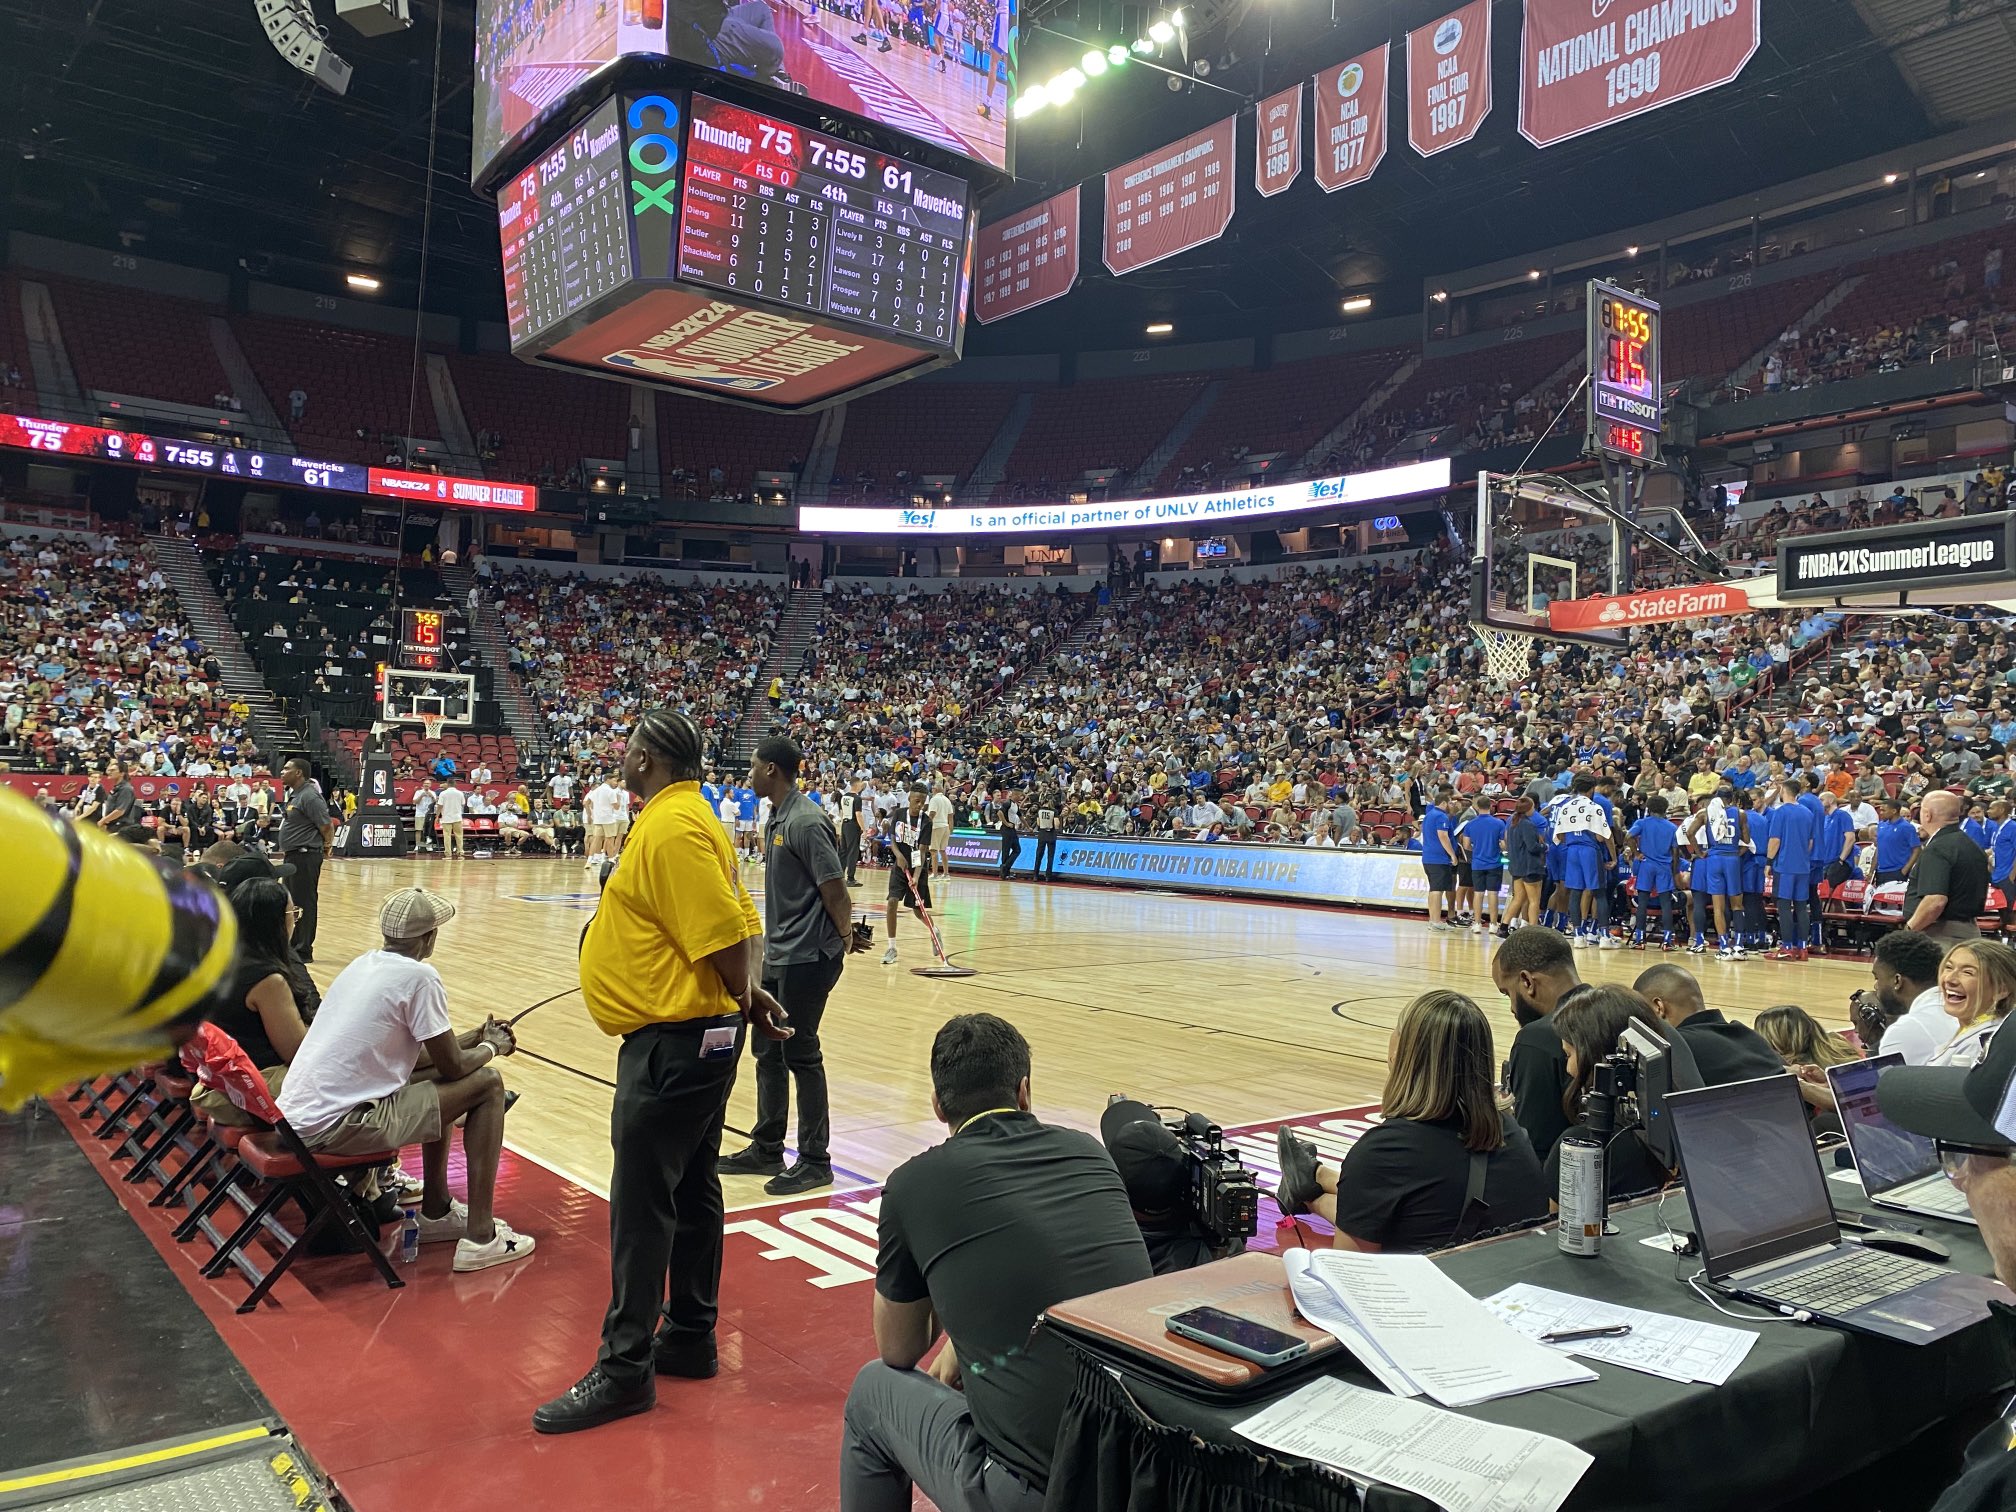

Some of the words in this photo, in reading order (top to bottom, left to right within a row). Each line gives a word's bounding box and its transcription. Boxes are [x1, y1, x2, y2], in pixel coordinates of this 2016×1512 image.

[1537, 21, 1619, 88] NATIONAL
[1624, 0, 1738, 56] CHAMPIONS
[1437, 55, 1458, 81] NCAA
[1605, 51, 1661, 108] 1990
[1427, 83, 1448, 107] FINAL
[1449, 71, 1469, 98] FOUR
[1340, 98, 1359, 122] NCAA
[1429, 94, 1466, 136] 1987
[1331, 124, 1349, 146] FINAL
[1350, 115, 1368, 138] FOUR
[521, 172, 535, 201] 75
[540, 147, 566, 187] 7:55
[573, 128, 588, 160] 61
[628, 95, 678, 216] COX
[693, 118, 752, 154] Thunder
[758, 123, 792, 155] 75
[809, 140, 866, 179] 7:55
[884, 165, 912, 194] 61
[913, 187, 963, 220] Mavericks
[1266, 151, 1290, 179] 1989
[1333, 136, 1365, 174] 1977
[693, 165, 721, 182] PLAYER
[733, 177, 748, 190] PTS
[759, 184, 774, 197] RBS
[785, 192, 799, 205] AST
[810, 199, 823, 211] FLS
[756, 164, 773, 179] FLS
[780, 171, 789, 186] 0
[821, 184, 848, 203] 4th
[877, 200, 893, 215] FLS
[901, 207, 907, 221] 1
[686, 205, 710, 219] Dieng
[730, 213, 744, 229] 11
[759, 221, 767, 235] 3
[785, 228, 793, 242] 3
[809, 235, 818, 249] 0
[688, 186, 726, 203] Holmgren
[732, 194, 747, 210] 12
[761, 202, 769, 216] 9
[787, 210, 794, 224] 1
[811, 217, 819, 231] 3
[684, 225, 709, 239] Butler
[731, 234, 739, 248] 9
[758, 241, 764, 255] 1
[784, 248, 792, 262] 5
[808, 255, 816, 269] 2
[837, 227, 858, 242] Lively
[875, 235, 883, 249] 3
[898, 242, 906, 255] 4
[921, 249, 929, 262] 0
[942, 255, 949, 268] 4
[839, 208, 865, 223] PLAYER
[874, 218, 887, 230] PTS
[897, 225, 910, 237] RBS
[919, 232, 933, 243] AST
[941, 238, 953, 250] FLS
[681, 263, 704, 277] Mann
[728, 272, 736, 286] 6
[754, 278, 763, 292] 0
[780, 285, 788, 299] 5
[806, 291, 812, 305] 1
[683, 244, 722, 261] Shackelford
[729, 253, 738, 267] 6
[757, 260, 763, 274] 1
[783, 267, 789, 281] 1
[807, 273, 813, 287] 1
[833, 265, 861, 279] Lawson
[872, 272, 880, 285] 9
[895, 278, 903, 292] 3
[919, 285, 925, 298] 1
[940, 291, 946, 304] 1
[835, 245, 857, 260] Hardy
[871, 252, 885, 267] 17
[897, 260, 904, 273] 4
[920, 266, 926, 280] 1
[941, 272, 947, 285] 1
[1728, 274, 1752, 290] 226
[830, 301, 854, 315] Wright
[869, 308, 877, 321] 4
[892, 314, 900, 327] 2
[915, 320, 922, 333] 3
[936, 325, 943, 338] 0
[832, 283, 860, 298] Prosper
[871, 290, 879, 303] 7
[894, 296, 901, 309] 0
[916, 302, 924, 315] 0
[937, 308, 945, 321] 2
[639, 300, 736, 350] NBA2K24
[676, 311, 815, 364] SUMMER
[1329, 327, 1348, 340] 224
[1503, 326, 1524, 340] 225
[1613, 302, 1650, 343] 7:55
[739, 334, 865, 376] LEAGUE
[1619, 340, 1645, 392] 15
[1616, 397, 1657, 420] TISSOT
[16, 417, 70, 433] Thunder
[107, 435, 122, 449] 0
[141, 441, 152, 452] 0
[165, 445, 214, 467] 7:55
[251, 455, 263, 469] 0
[292, 457, 345, 473] Mavericks
[27, 429, 62, 451] 75
[139, 453, 154, 462] FLS
[222, 464, 236, 473] FLS
[303, 469, 330, 487] 61
[381, 477, 431, 492] NBA2K24
[453, 483, 490, 503] SUMMER
[492, 487, 523, 506] LEAGUE
[903, 511, 936, 528] Yes!
[971, 514, 982, 527] Is
[988, 515, 1006, 526] an
[1012, 512, 1065, 526] official
[1071, 509, 1129, 526] partner
[1135, 505, 1151, 520] of
[1156, 502, 1199, 519] UNLV
[1204, 494, 1275, 514] Athletics
[1312, 477, 1346, 499] Yes!
[1798, 539, 1994, 580] #NBA2KSummerLeague
[414, 645, 440, 653] TISSOT
[417, 625, 435, 644] 15
[374, 829, 396, 838] SUMMER
[374, 838, 393, 846] LEAGUE
[1068, 849, 1138, 871] SPEAKING
[1140, 854, 1191, 875] TRUTH
[1192, 856, 1214, 877] TO
[1214, 858, 1249, 879] NBA
[1251, 860, 1299, 883] HYPE
